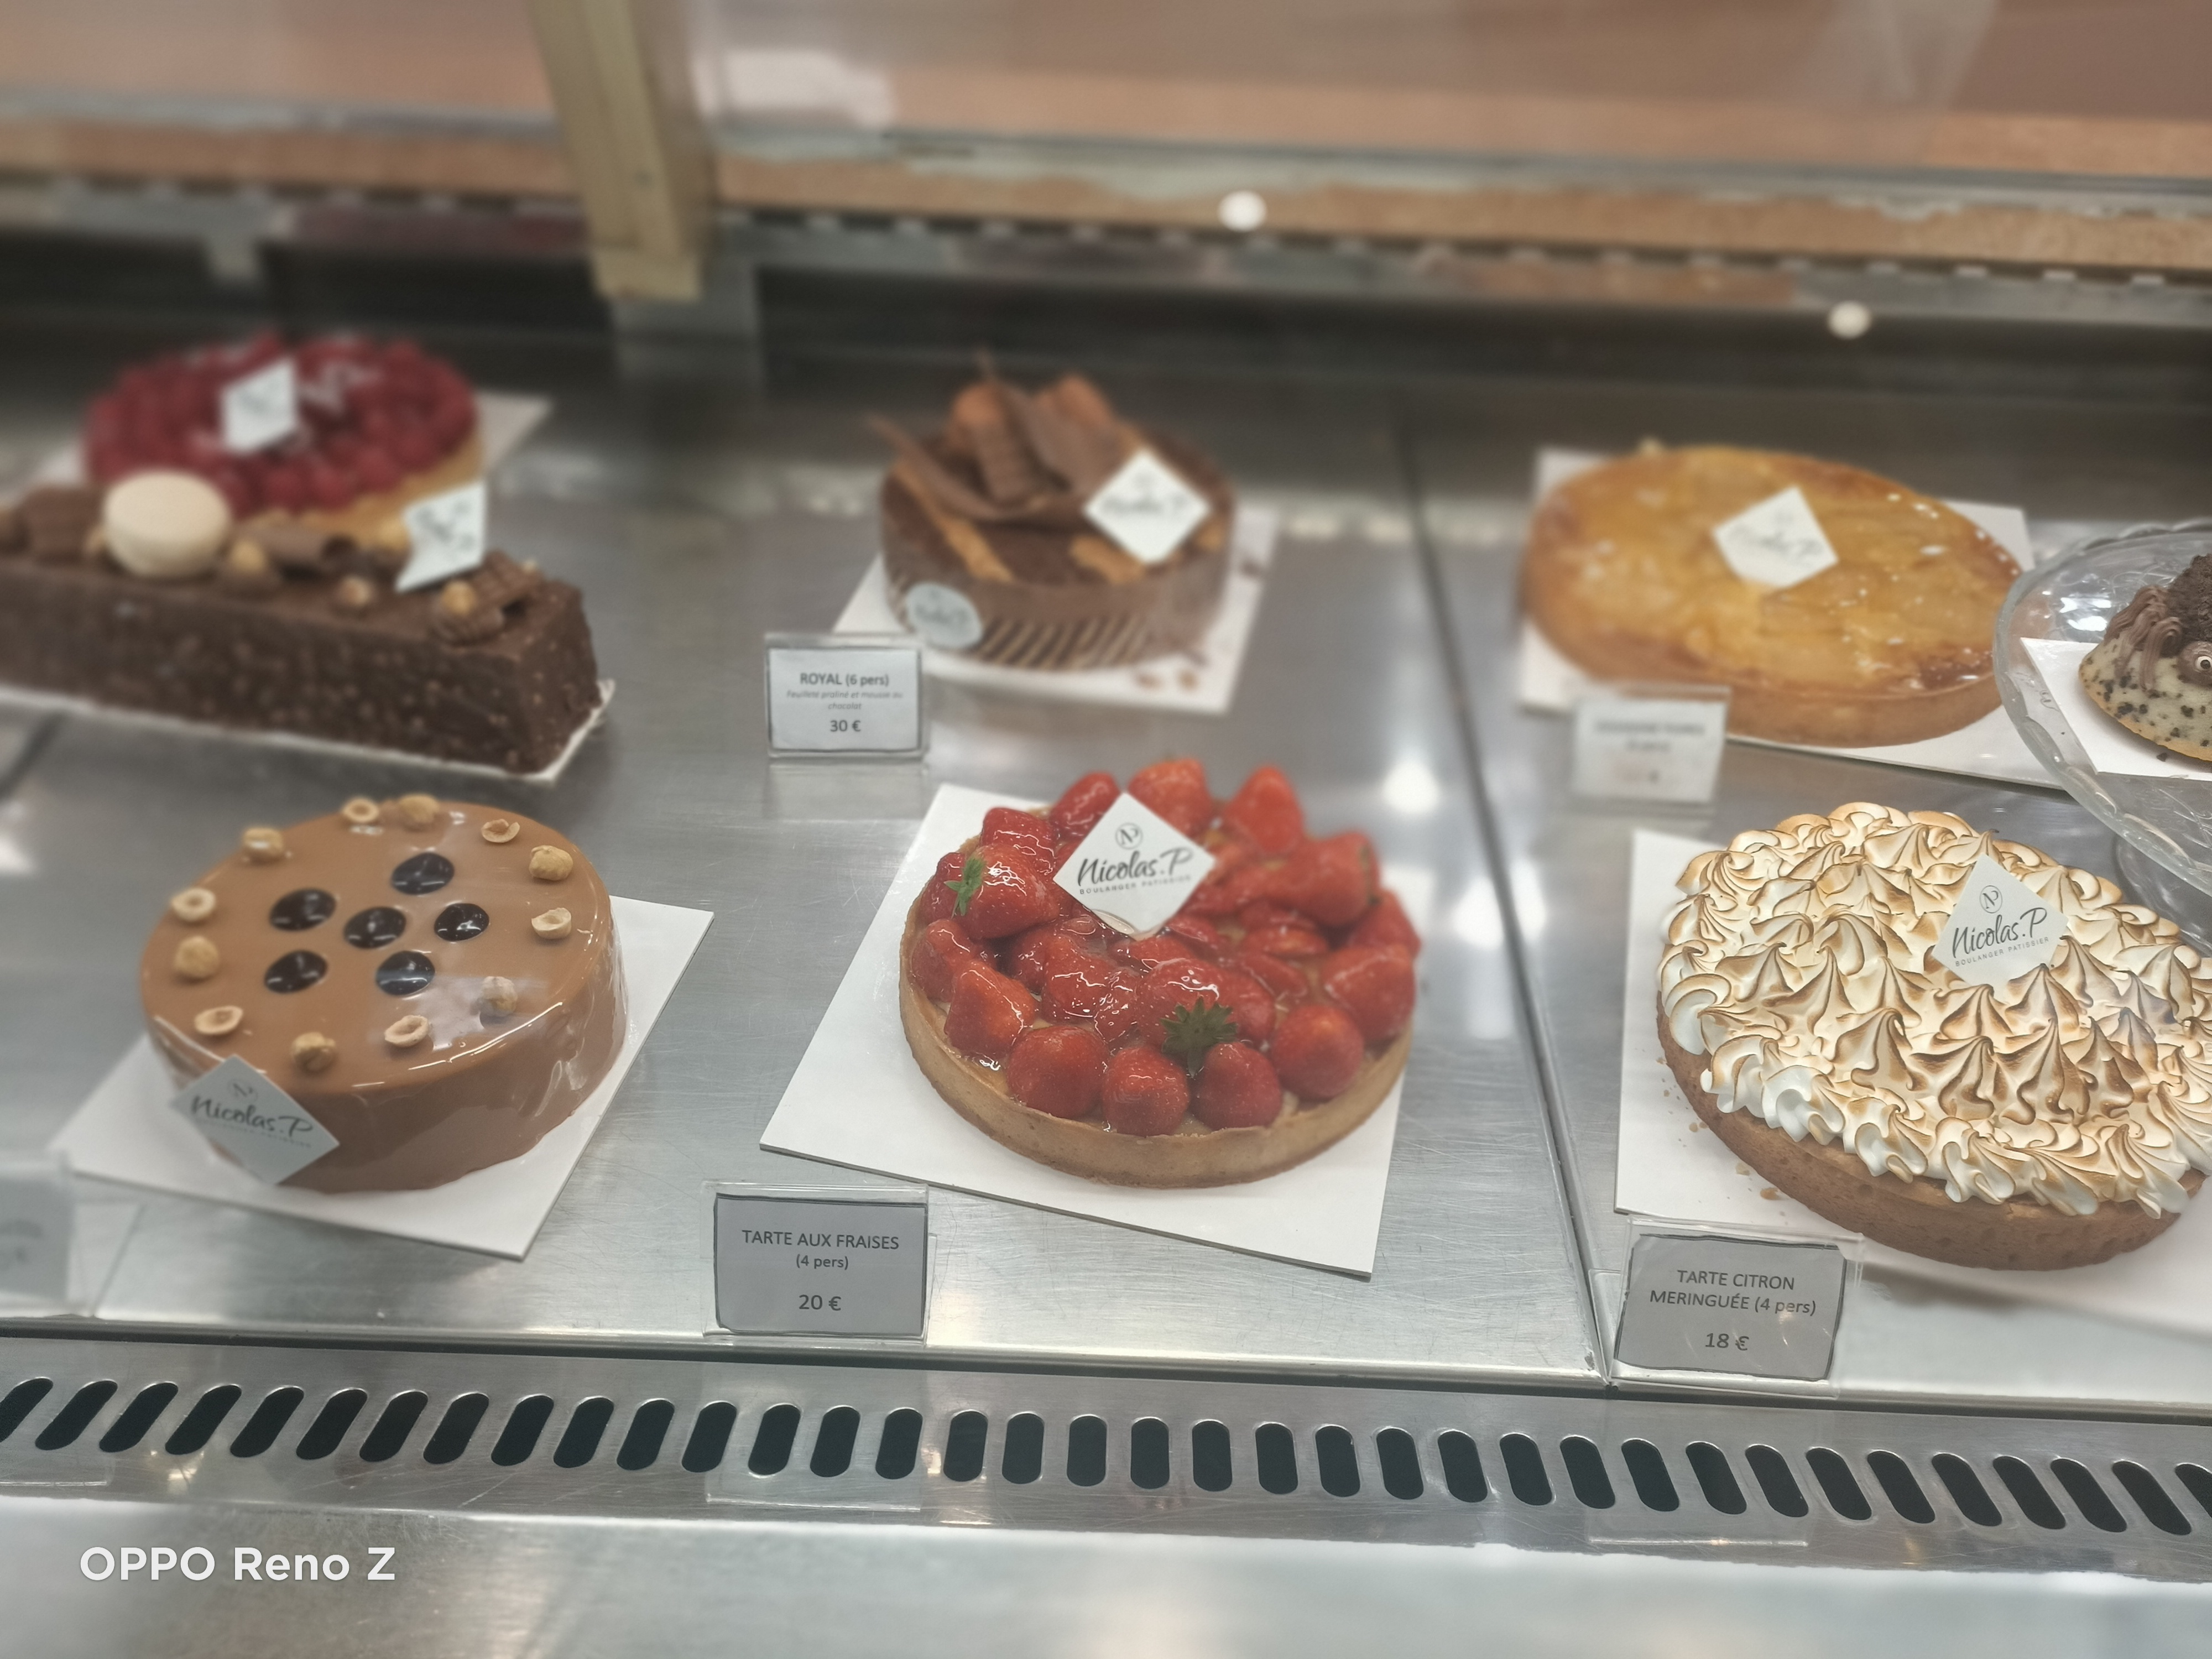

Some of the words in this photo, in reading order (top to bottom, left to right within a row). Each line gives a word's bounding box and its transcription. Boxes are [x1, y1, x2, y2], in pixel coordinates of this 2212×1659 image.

[800, 672, 842, 685] ROYAL
[846, 674, 857, 687] (6
[860, 674, 889, 687] pers)
[821, 691, 849, 699] praliné
[831, 720, 848, 732] 30
[852, 720, 861, 732] €
[1079, 883, 1137, 895] BOULANGER
[1955, 948, 2005, 967] BOULANGER
[2008, 936, 2049, 952] PATISSIER
[742, 1230, 792, 1245] TARTE
[797, 1233, 832, 1247] AUX
[837, 1234, 900, 1250] FRAISES
[796, 1254, 809, 1269] (4
[814, 1256, 849, 1270] pers)
[1677, 1270, 1728, 1286] TARTE
[1733, 1274, 1794, 1290] CITRON
[799, 1295, 823, 1310] 20
[828, 1296, 841, 1311] €
[1650, 1290, 1749, 1310] MERINGUÉE
[1755, 1296, 1770, 1313] (4
[1775, 1300, 1816, 1316] pers)
[1705, 1333, 1729, 1349] 18
[1735, 1335, 1749, 1351] €
